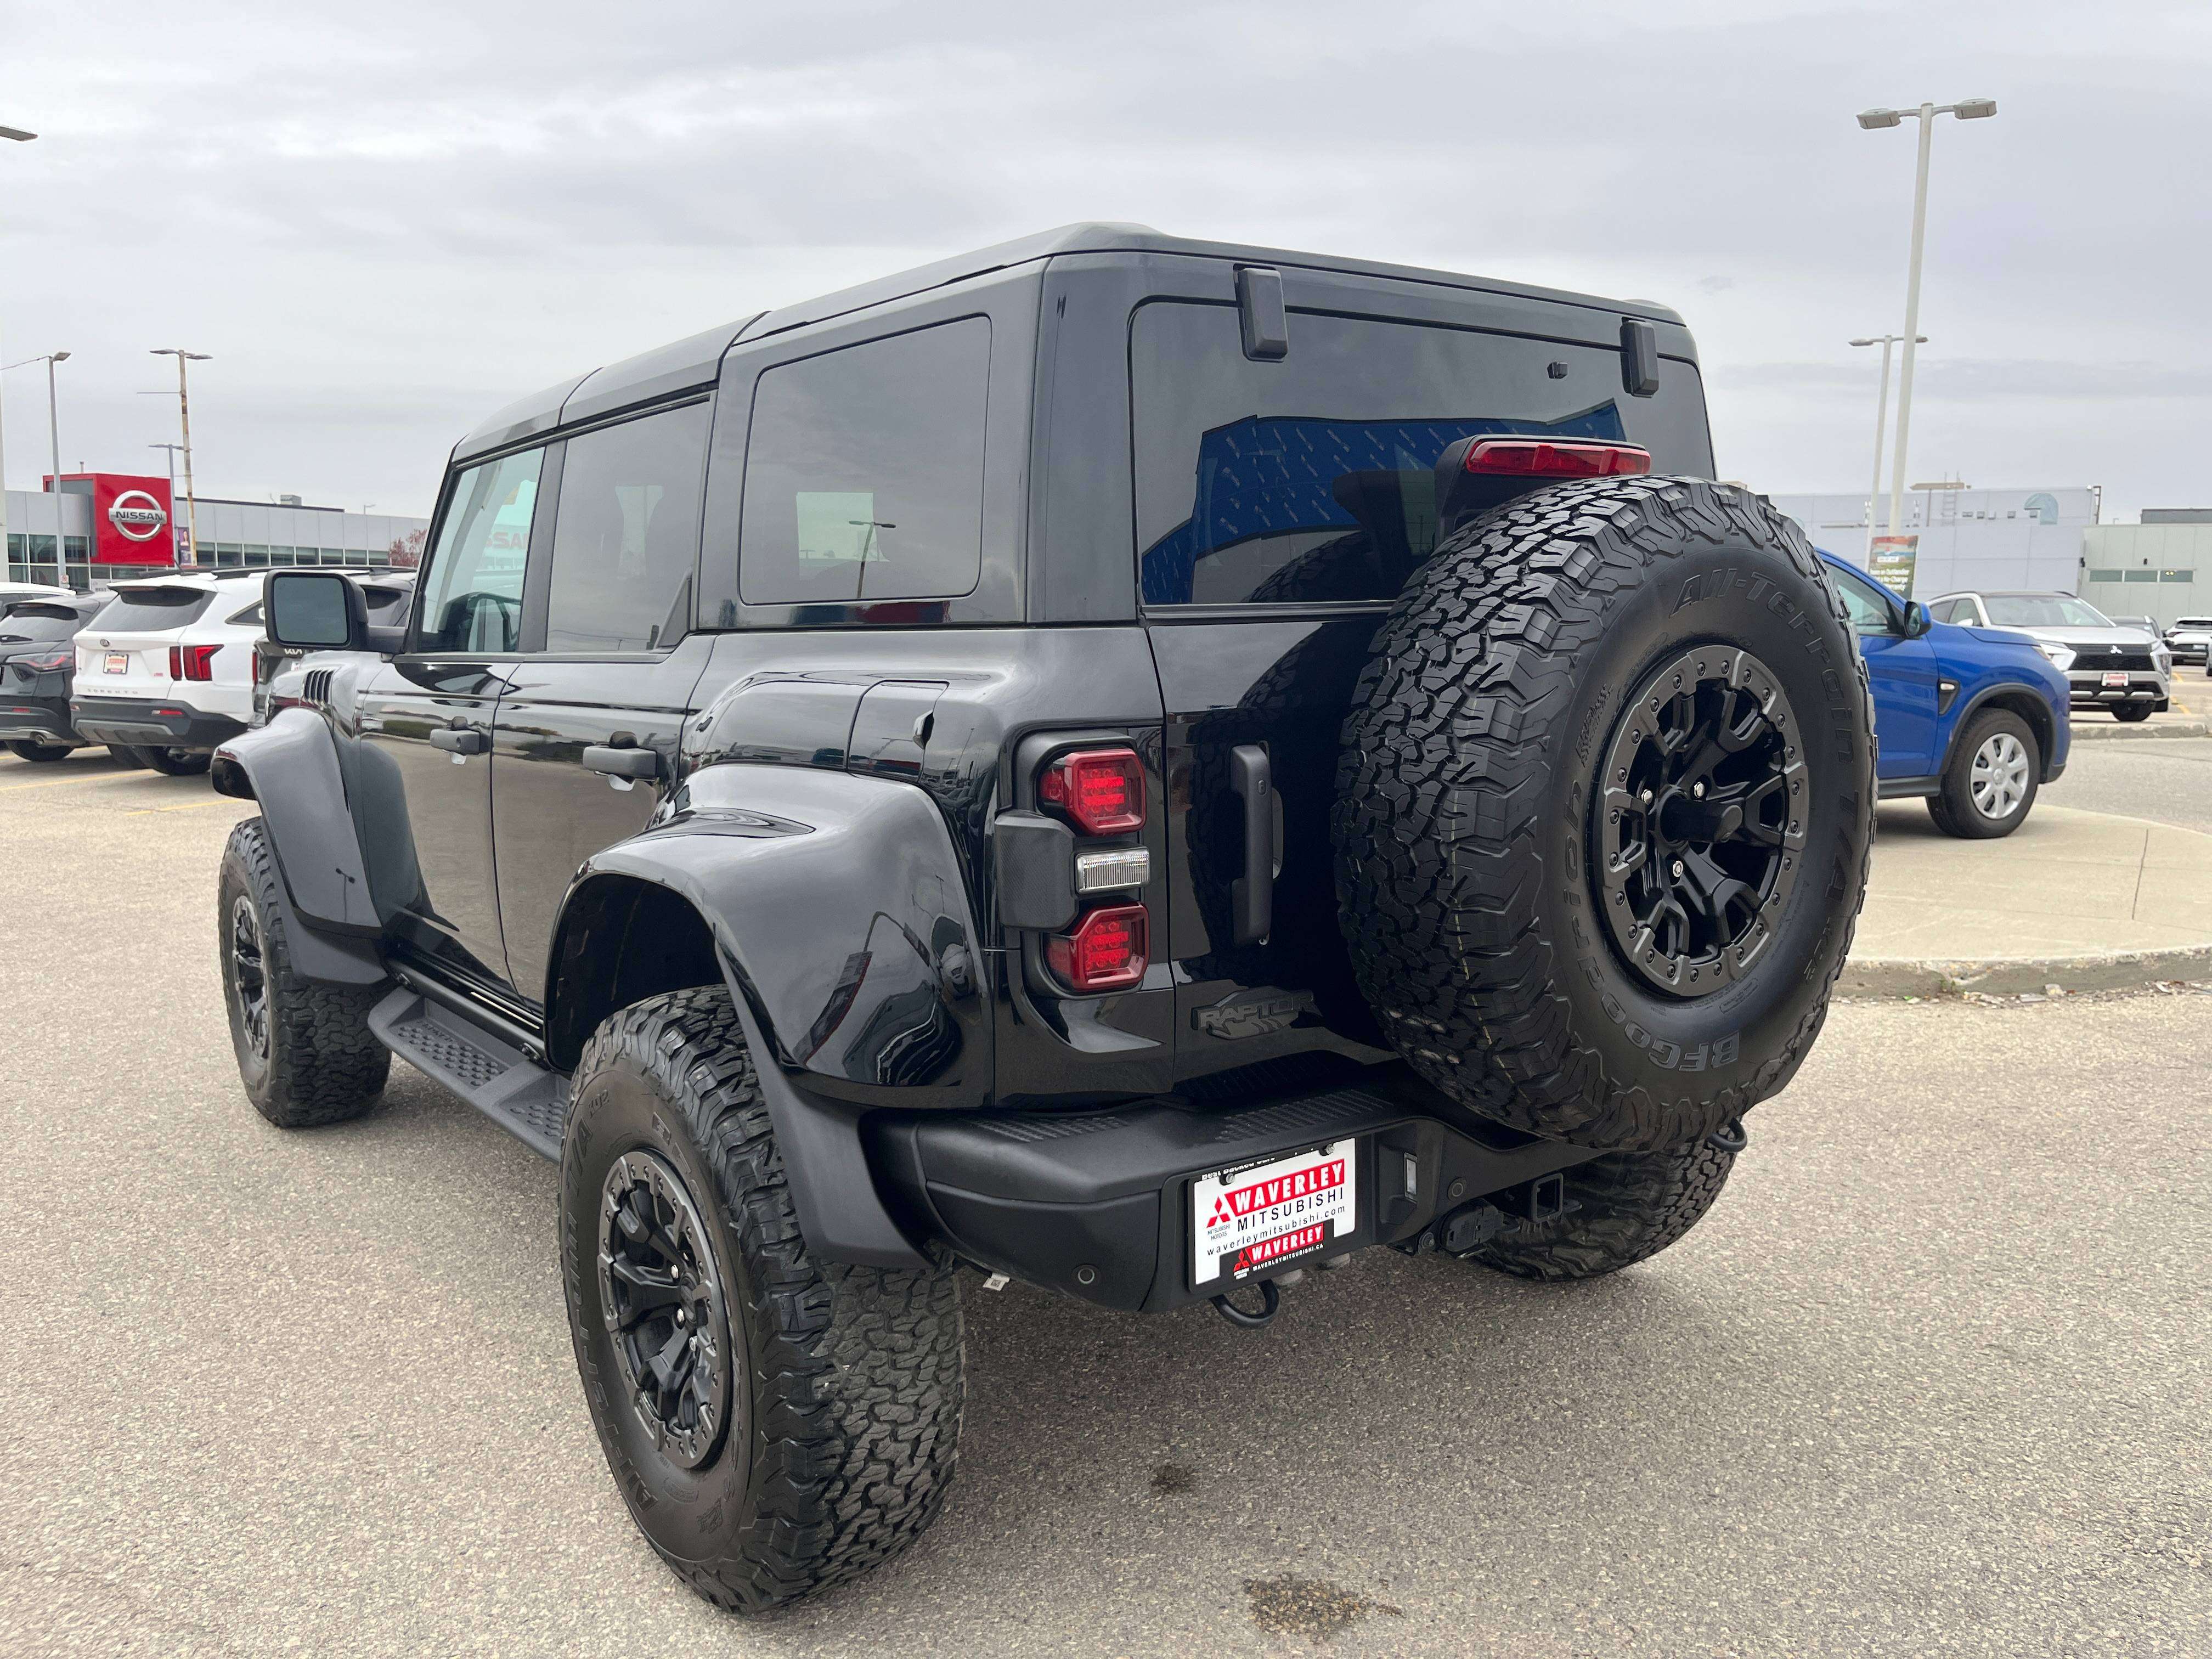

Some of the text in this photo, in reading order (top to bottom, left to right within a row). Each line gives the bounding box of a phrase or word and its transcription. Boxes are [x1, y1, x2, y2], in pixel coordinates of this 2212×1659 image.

[116, 511, 163, 521] NISSAN
[1668, 567, 1854, 764] All-Terrain
[1562, 781, 1741, 1073] BFGoodrich
[1234, 1161, 1343, 1214] WAVERLEY
[1238, 1187, 1343, 1232] MITSUBISHI
[1207, 1205, 1345, 1256] waverleymitsubishi.com
[1251, 1226, 1322, 1262] WAVERLEY
